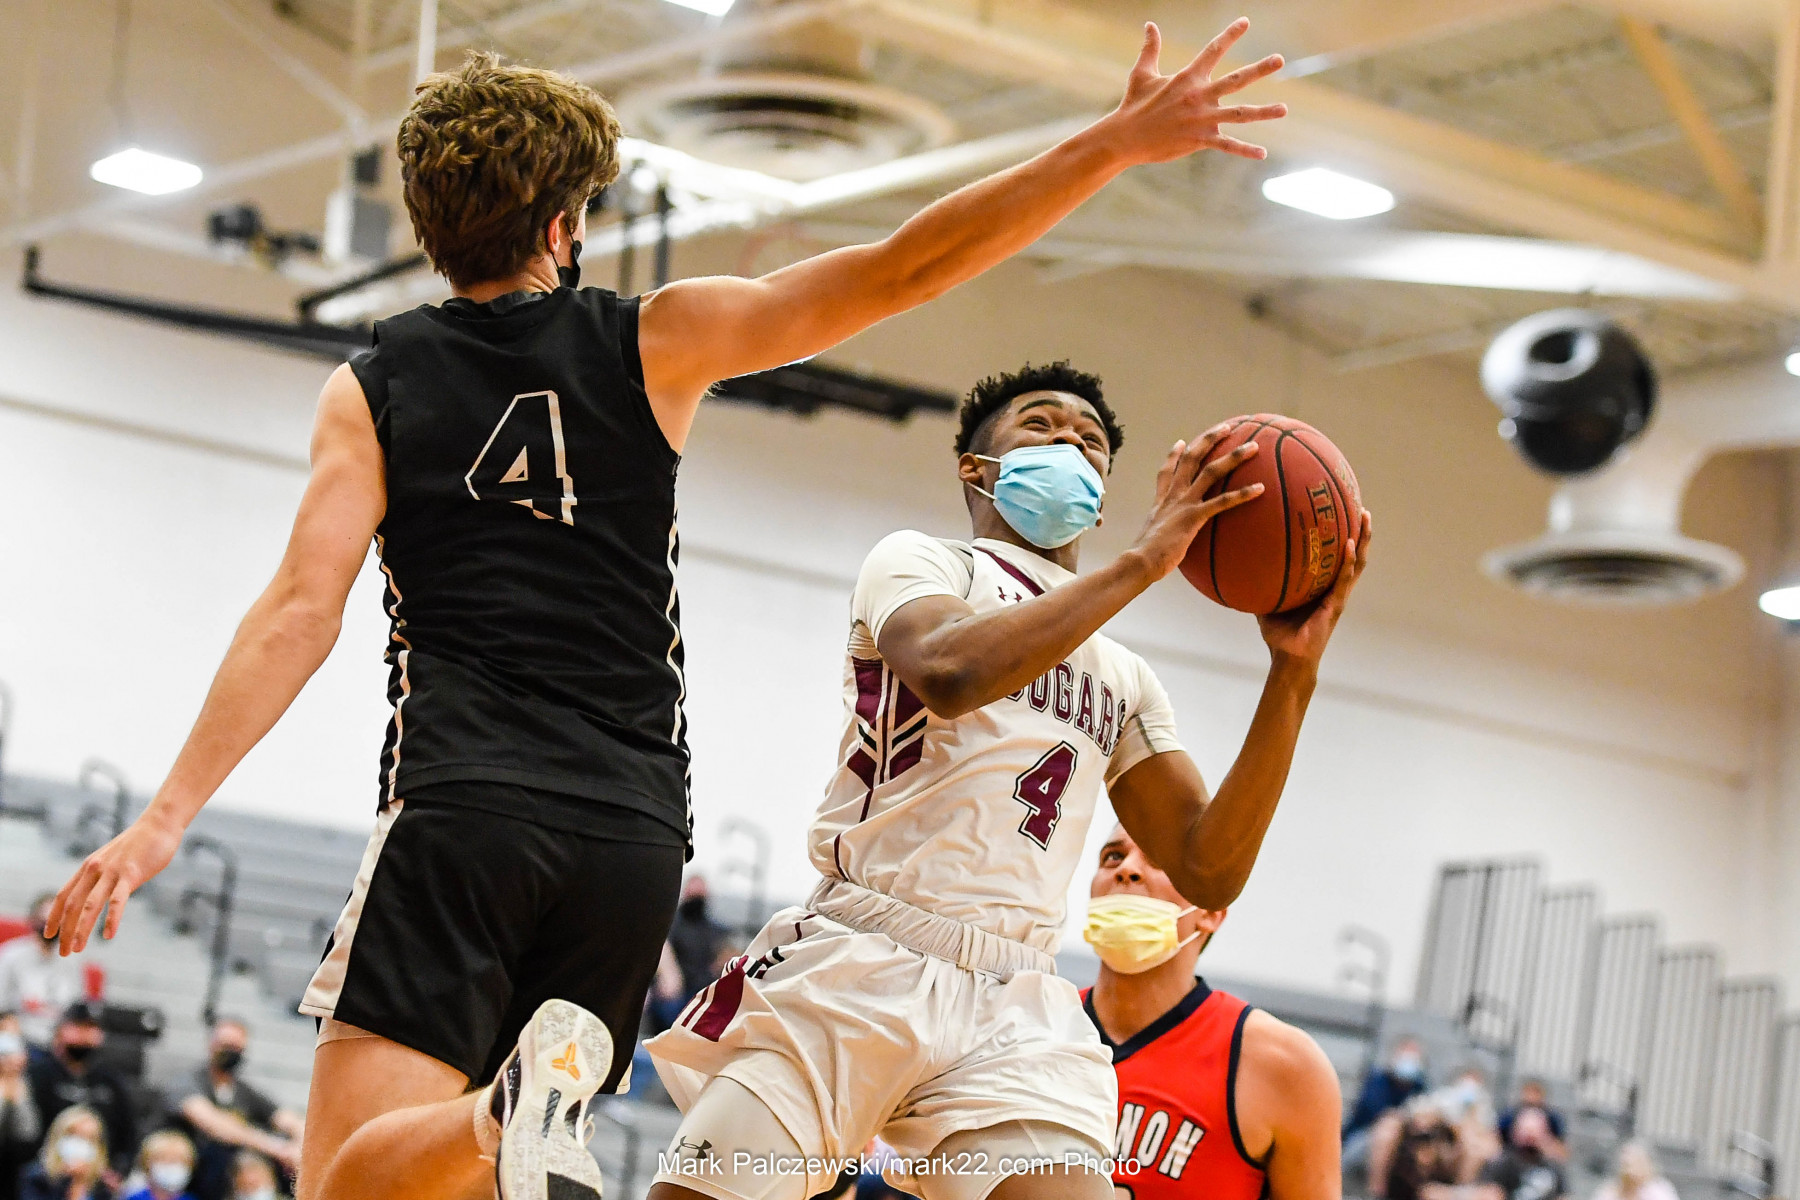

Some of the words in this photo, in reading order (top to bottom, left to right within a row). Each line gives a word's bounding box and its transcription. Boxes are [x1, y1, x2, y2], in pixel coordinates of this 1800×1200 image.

[463, 390, 578, 526] 4
[1012, 740, 1079, 852] 4
[1113, 1101, 1207, 1181] NON
